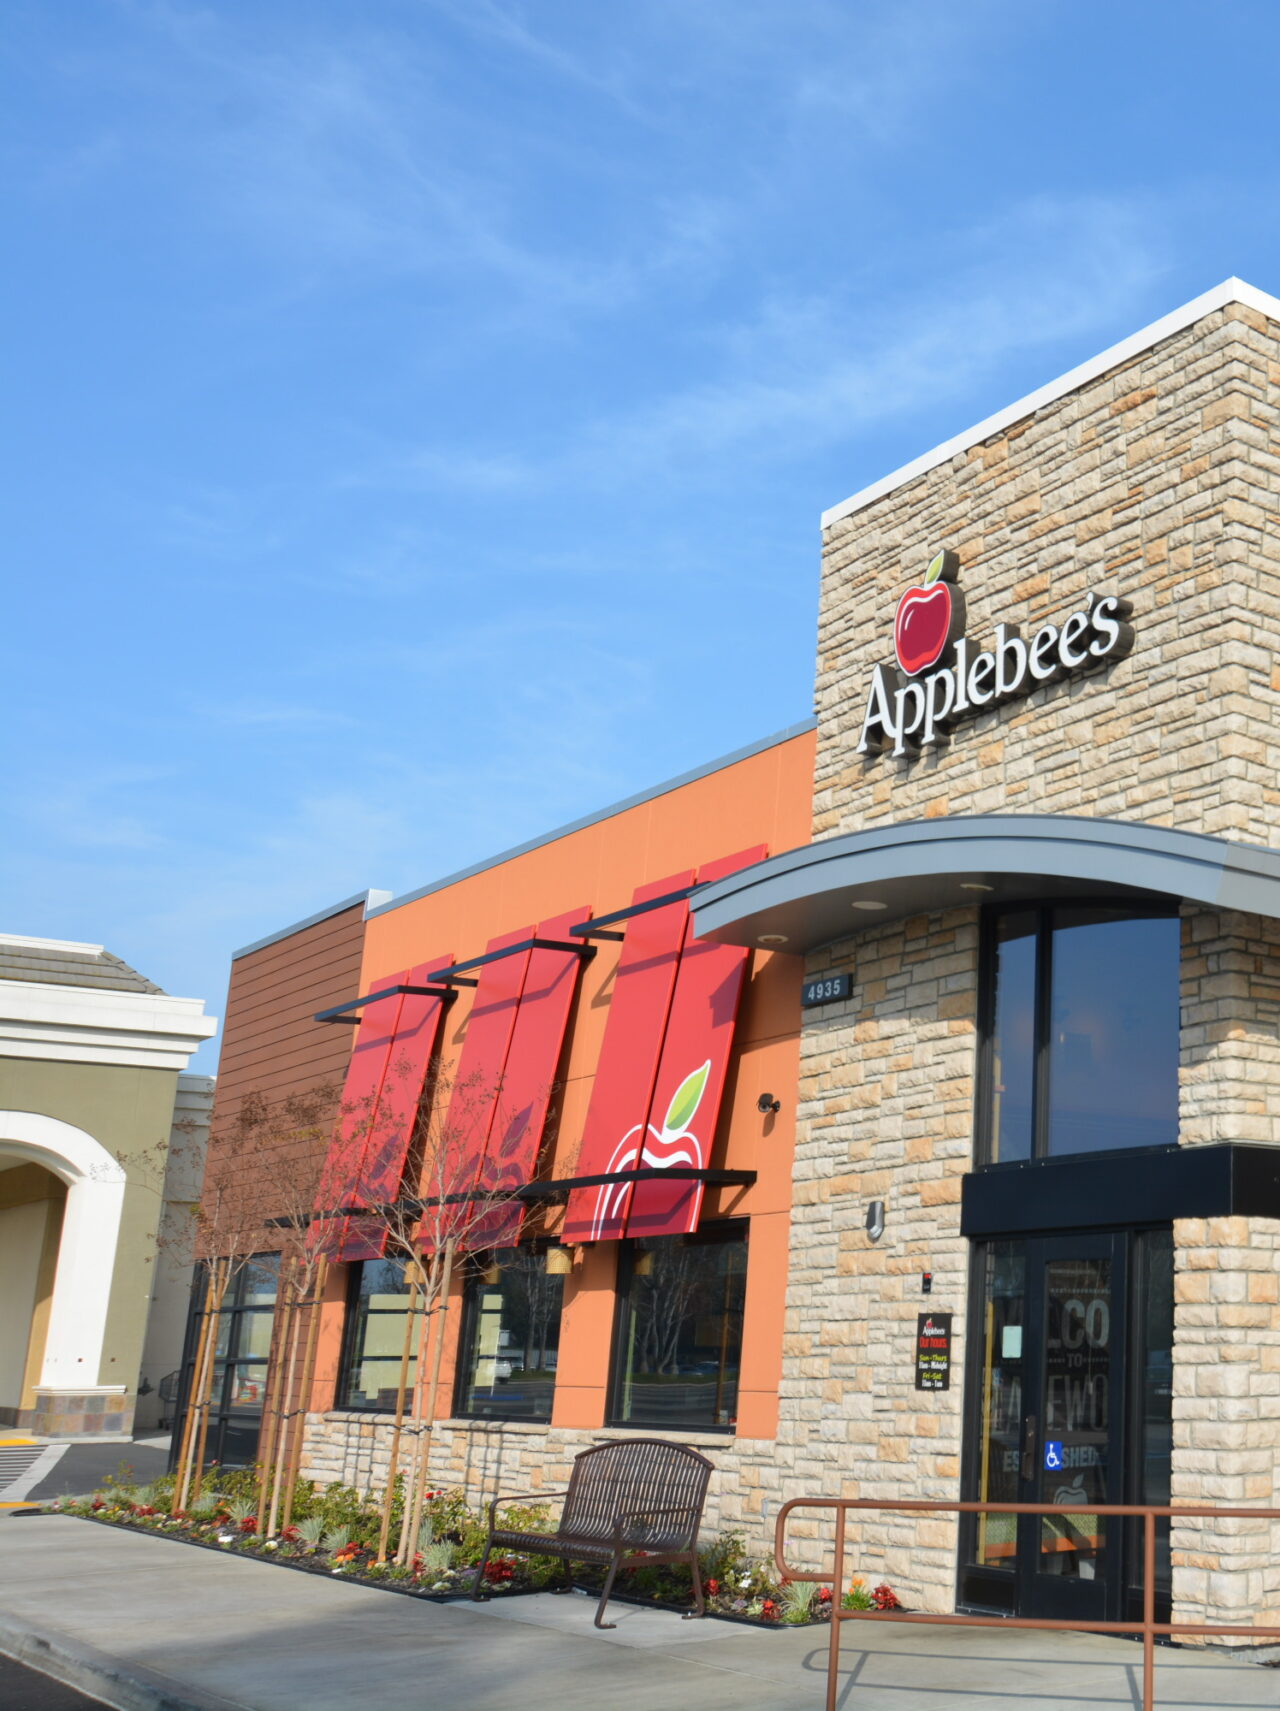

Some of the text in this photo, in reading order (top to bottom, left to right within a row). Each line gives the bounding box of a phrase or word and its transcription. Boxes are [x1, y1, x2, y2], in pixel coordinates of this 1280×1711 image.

[856, 591, 1118, 758] Applebee's
[807, 979, 841, 1001] 4935
[1066, 1352, 1083, 1369] TO
